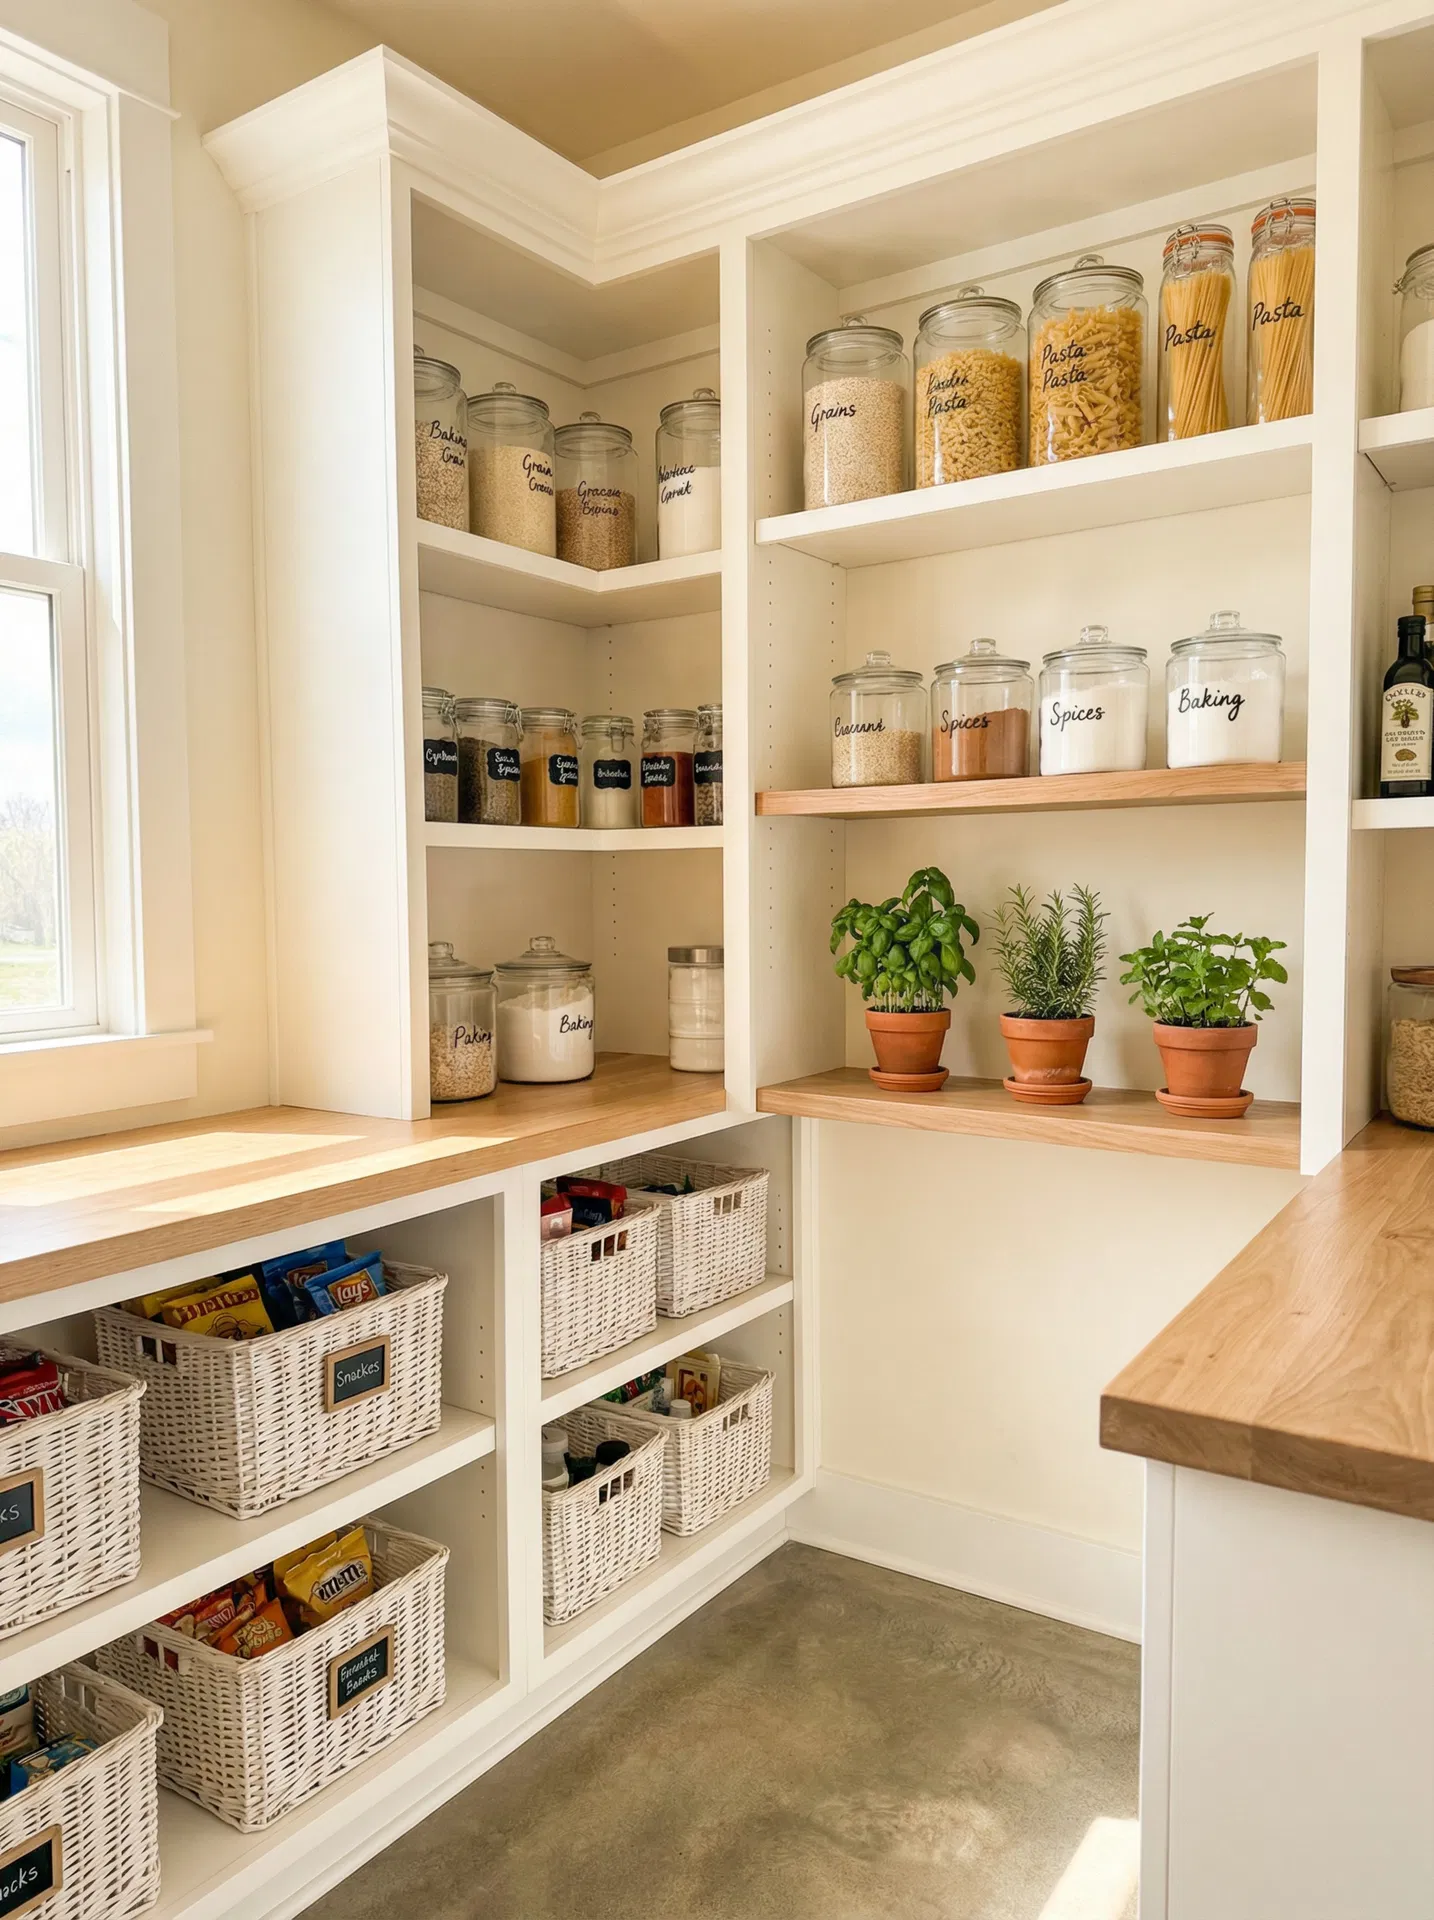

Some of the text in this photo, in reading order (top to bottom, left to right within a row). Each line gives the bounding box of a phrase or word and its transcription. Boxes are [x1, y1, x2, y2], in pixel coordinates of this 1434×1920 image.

[1252, 297, 1305, 331] Pasta
[1041, 340, 1087, 370] Pasta
[1042, 364, 1088, 393] Pasta
[811, 402, 857, 432] Grains
[927, 391, 968, 419] Pasta
[1050, 701, 1106, 731] Spices
[1178, 687, 1246, 721] Baking
[940, 709, 992, 739] Spices
